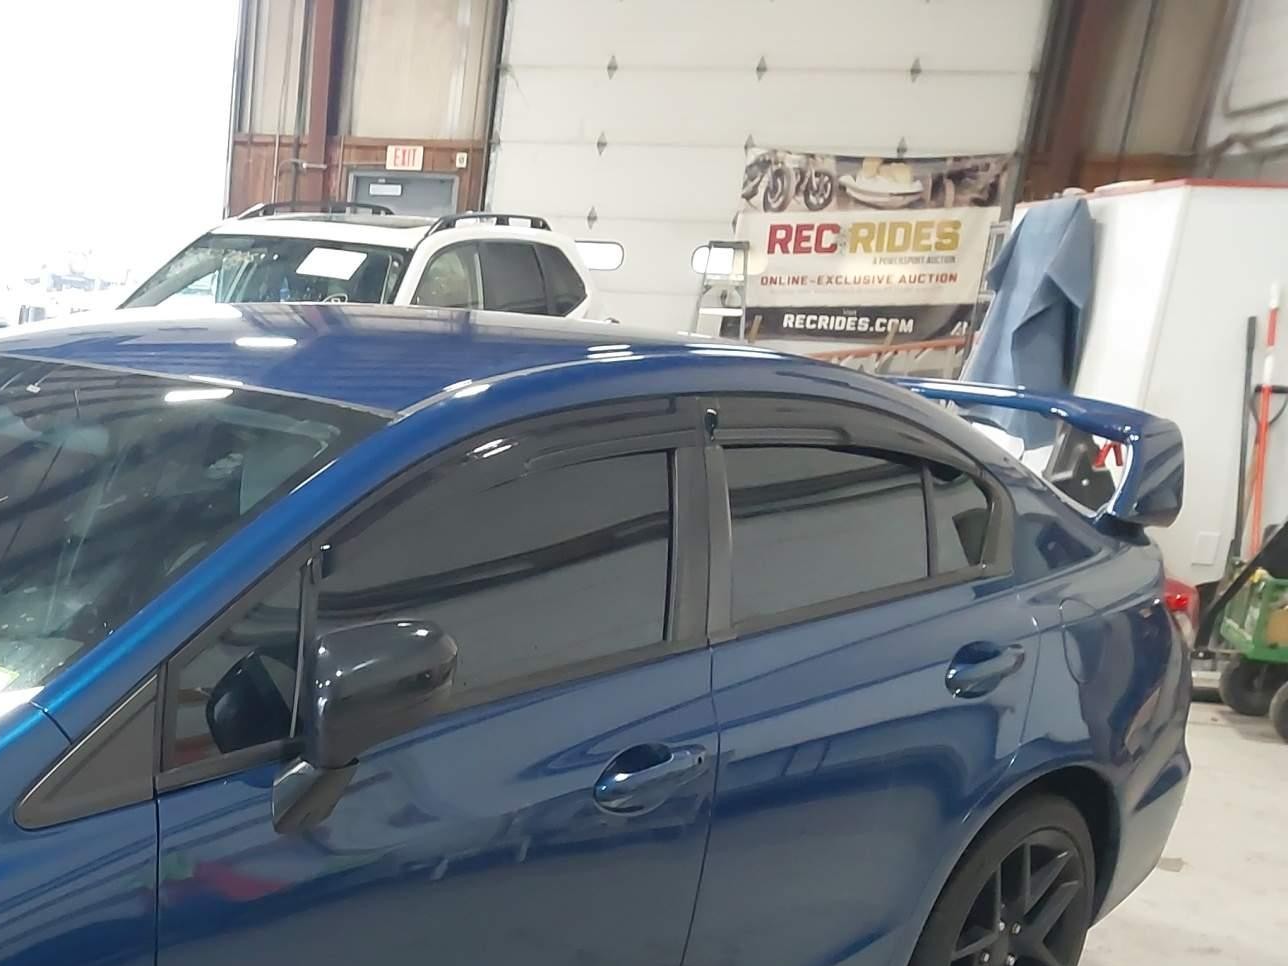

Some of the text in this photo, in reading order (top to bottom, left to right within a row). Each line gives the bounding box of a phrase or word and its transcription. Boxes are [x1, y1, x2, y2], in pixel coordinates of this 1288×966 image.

[393, 148, 417, 167] EXIT
[767, 223, 840, 254] REC
[849, 220, 962, 254] RIDES
[926, 255, 956, 264] AUCTION
[760, 272, 958, 286] ONLINE-EXCLUSIVE AUCTION
[782, 313, 914, 334] RECRIDES.COM
